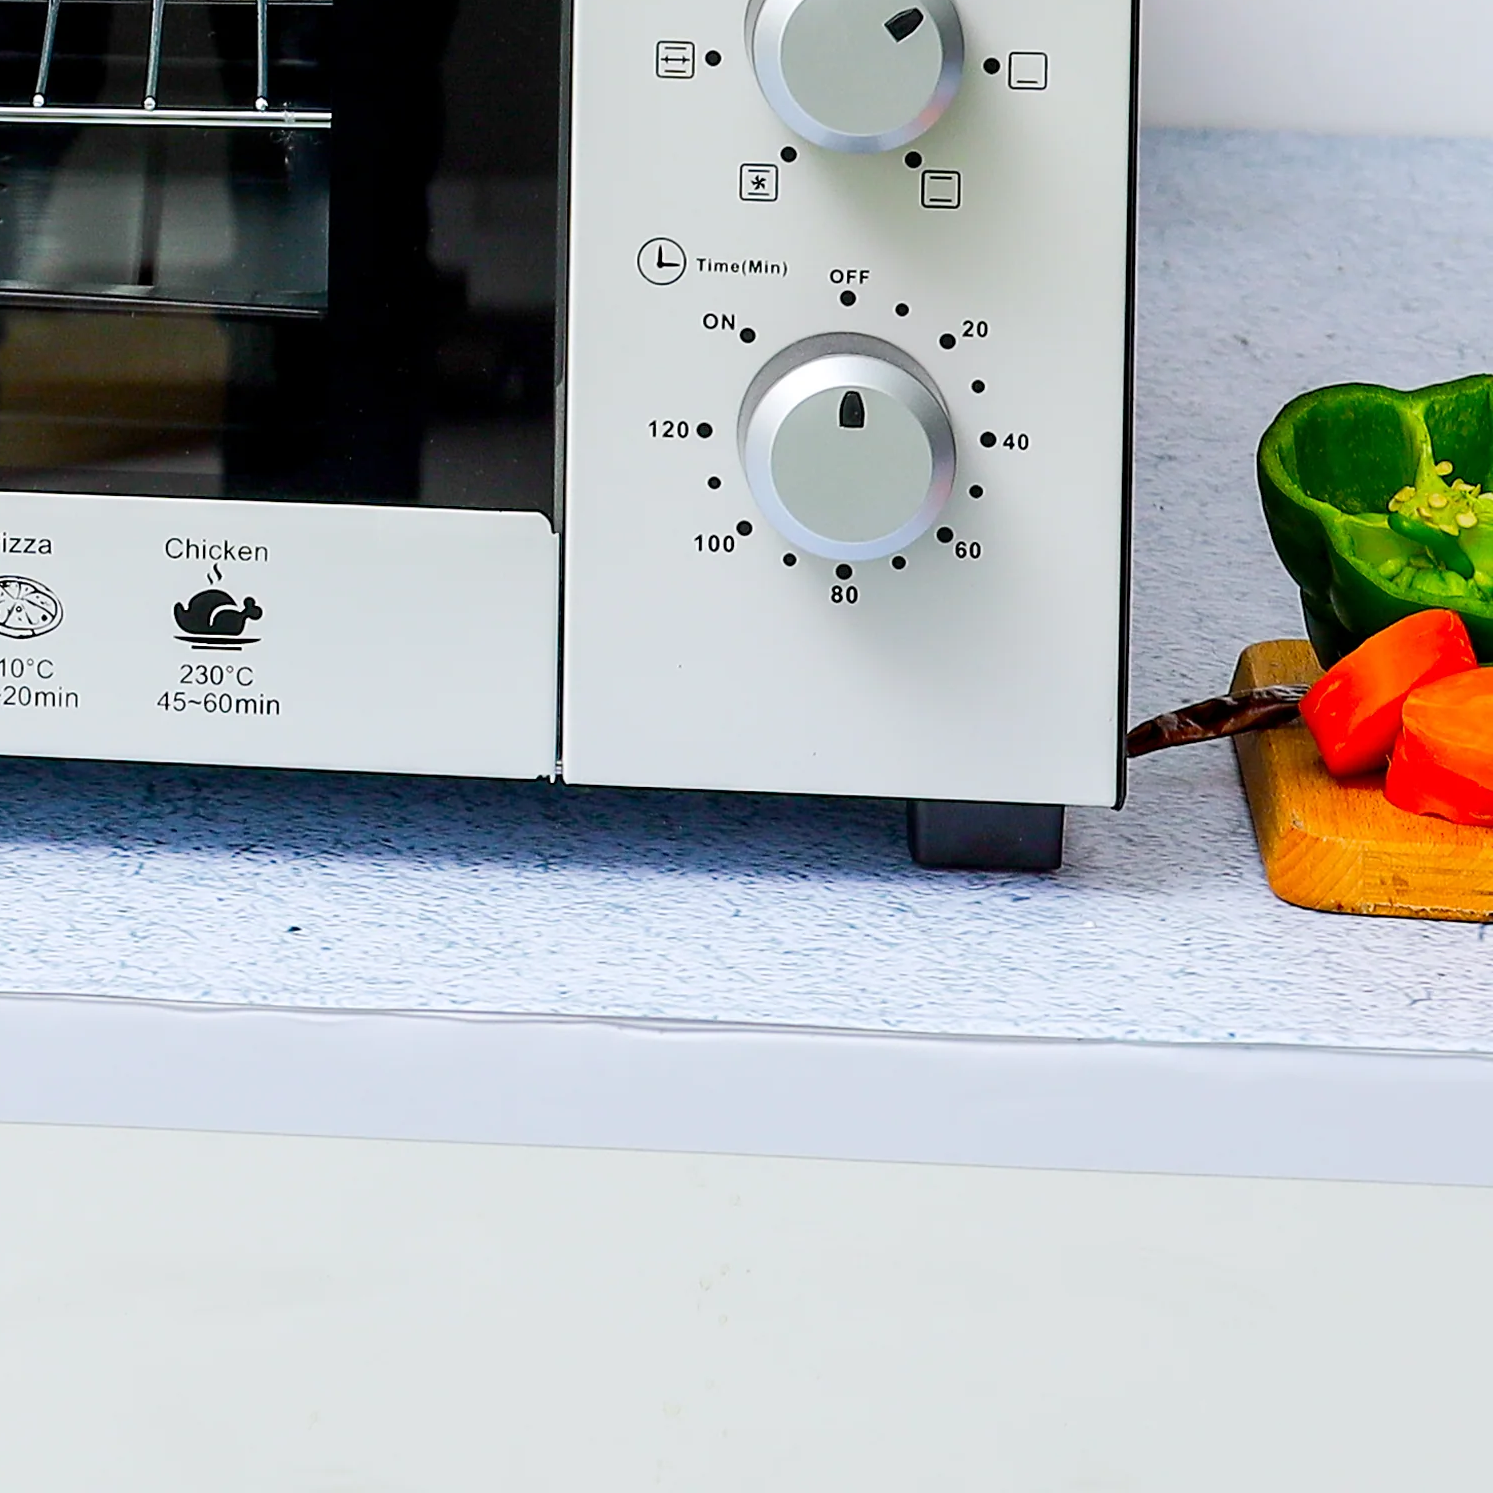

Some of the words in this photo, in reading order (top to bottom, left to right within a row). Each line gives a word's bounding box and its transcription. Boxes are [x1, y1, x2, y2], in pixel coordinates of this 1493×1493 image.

[695, 257, 788, 278] Time(Min)
[829, 268, 871, 285] OFF
[702, 312, 736, 331] ON
[961, 319, 989, 339] 20
[648, 419, 690, 439] 120
[1002, 432, 1030, 451] 40
[165, 537, 268, 562] Chicken
[693, 533, 735, 554] 100
[954, 540, 982, 560] 60
[830, 584, 859, 605] 80
[179, 663, 254, 687] 230°C
[156, 691, 280, 716] 45~60min
